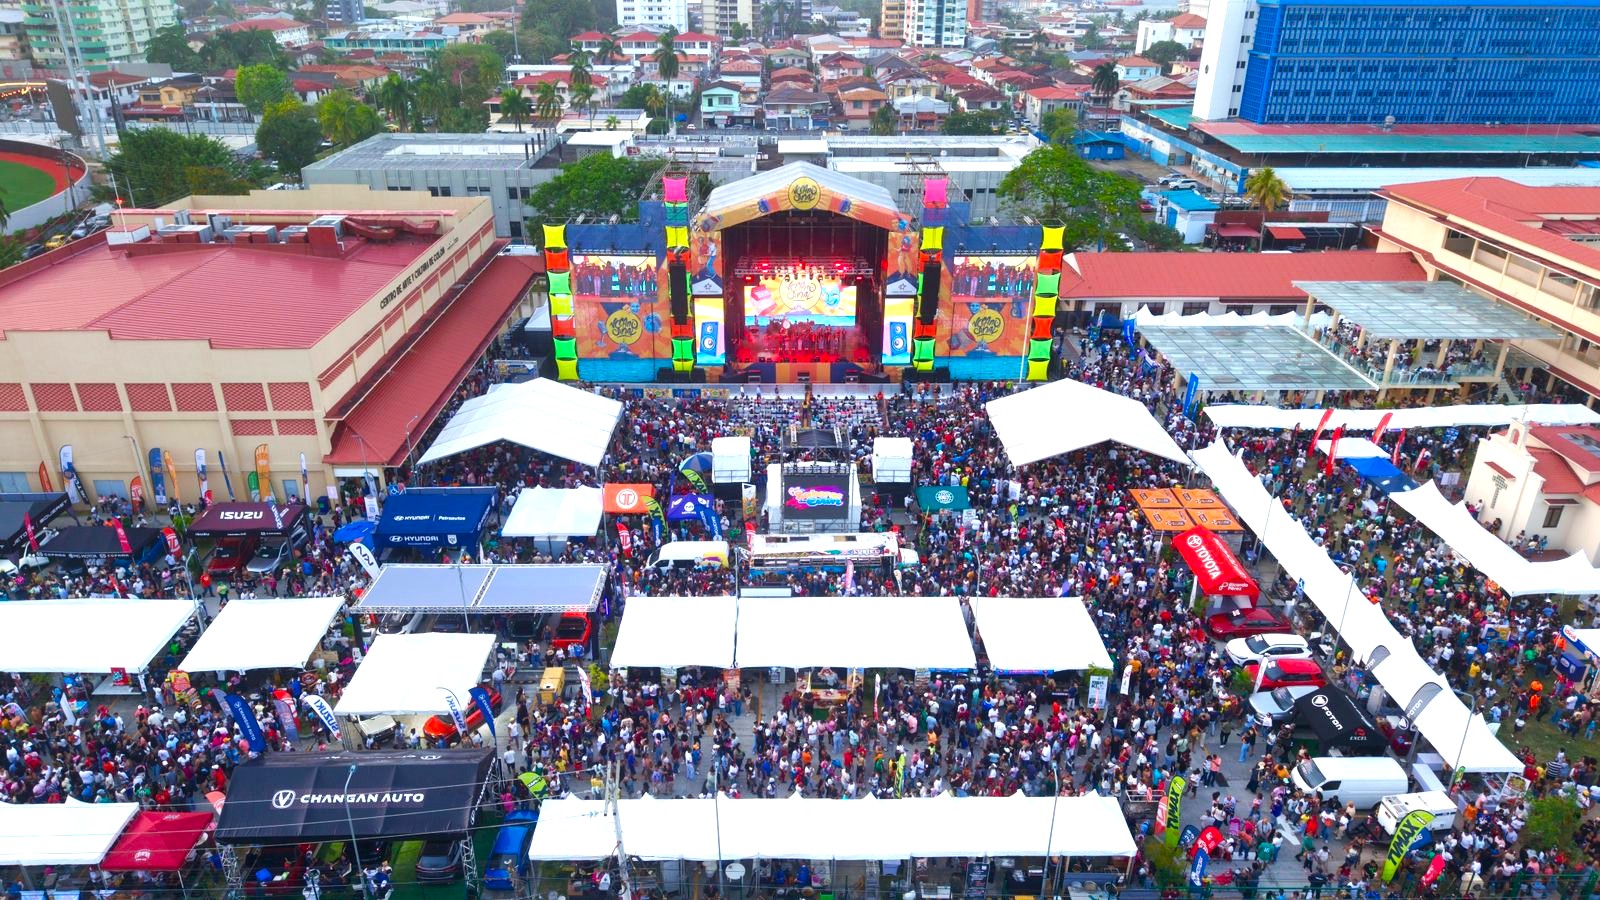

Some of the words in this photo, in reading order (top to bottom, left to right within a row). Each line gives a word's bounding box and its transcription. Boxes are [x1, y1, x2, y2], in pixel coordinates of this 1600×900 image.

[380, 290, 396, 309] CENTRO
[396, 284, 402, 294] DE
[403, 275, 412, 290] ARTE
[220, 511, 263, 520] ISUZU
[1195, 546, 1222, 580] TOYOTA
[238, 707, 252, 730] CHANGAN
[1321, 706, 1344, 731] FOTON
[300, 793, 382, 803] CHANGAN
[383, 793, 425, 803] AUTO
[1167, 788, 1180, 829] TVMAX
[1388, 819, 1419, 866] TVMAX
